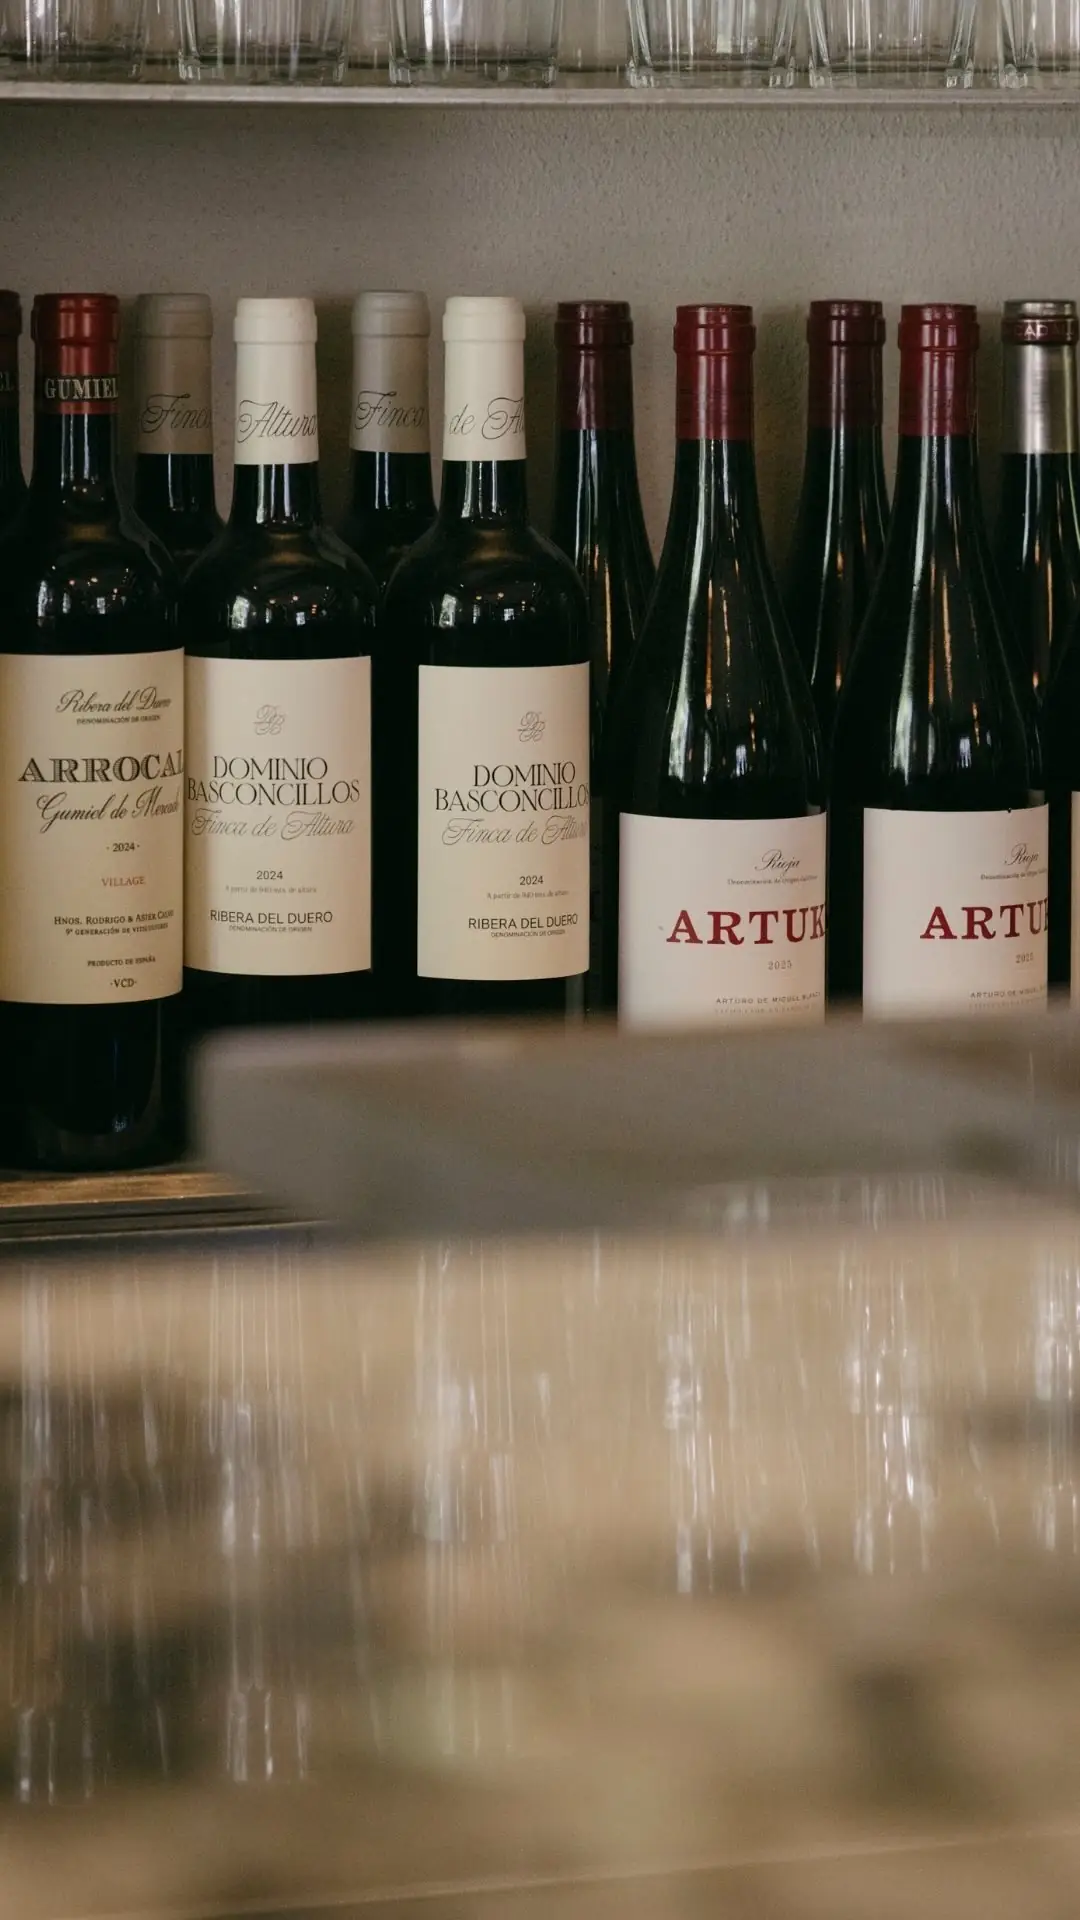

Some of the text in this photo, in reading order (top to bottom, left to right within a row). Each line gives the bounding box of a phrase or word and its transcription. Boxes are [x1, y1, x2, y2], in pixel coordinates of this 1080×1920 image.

[44, 377, 119, 400] GUMIEL
[235, 400, 318, 443] Altura
[449, 404, 476, 435] de
[113, 688, 139, 713] del
[213, 755, 328, 781] DOMINIO
[473, 761, 576, 787] DOMINIO
[187, 776, 361, 806] BASCONCILLOS
[36, 791, 116, 834] Gumiel
[110, 794, 129, 819] de
[191, 807, 355, 841] Finca de Altura
[442, 817, 513, 845] Finca
[515, 821, 541, 843] de
[754, 849, 801, 877] Rioja
[1004, 843, 1039, 871] Rioja
[101, 876, 146, 887] VILLAGE
[256, 870, 284, 880] 2024
[519, 875, 544, 885] 2024
[209, 909, 333, 925] RIBERA DEL DUERO
[468, 914, 579, 930] RIBERA DEL DUERO
[666, 903, 826, 945] ARTUK
[87, 959, 123, 967] PRODUCTO
[716, 997, 754, 1005] ARTURO
